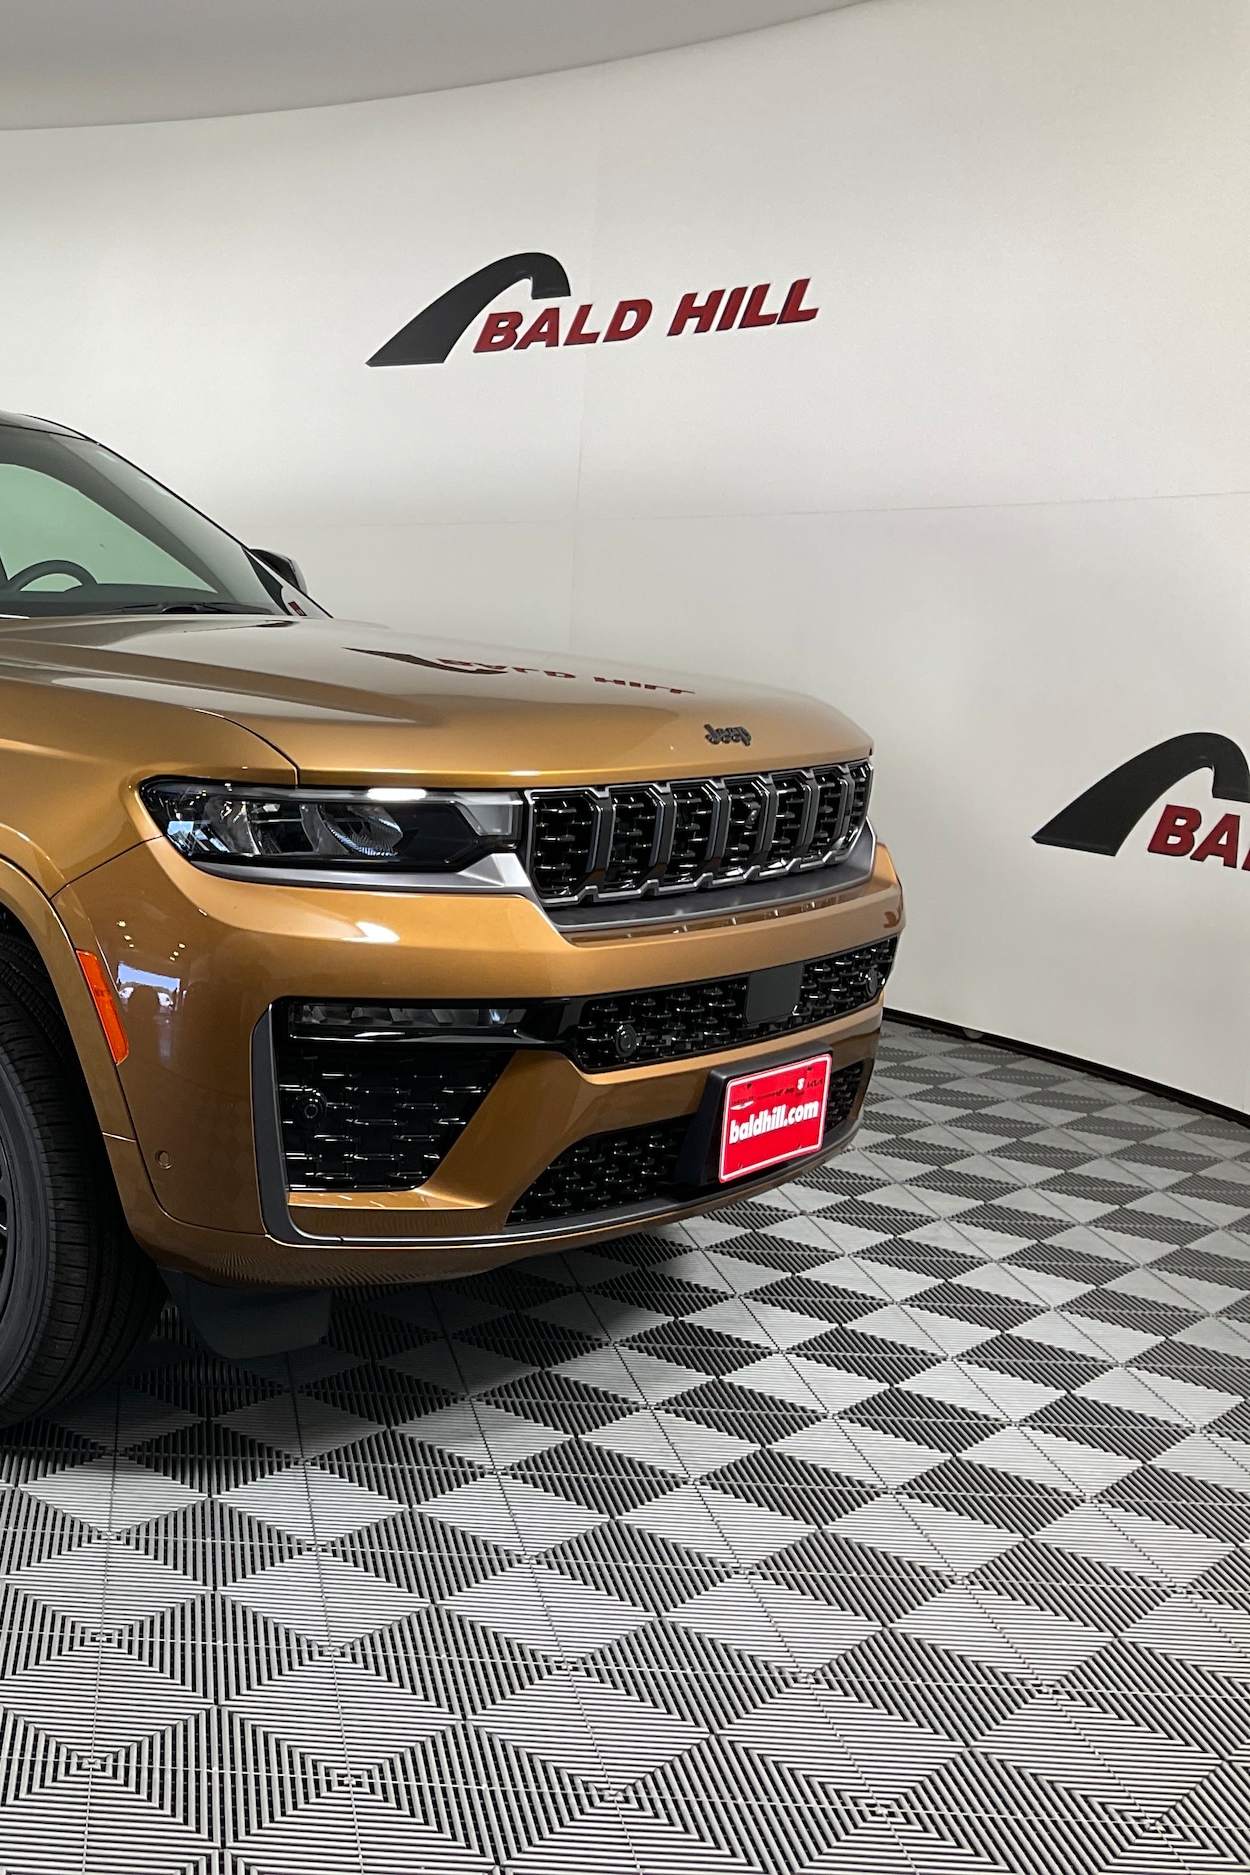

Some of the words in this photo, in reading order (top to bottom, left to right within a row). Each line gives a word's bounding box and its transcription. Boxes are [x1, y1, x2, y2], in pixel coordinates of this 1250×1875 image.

[472, 298, 654, 354] BALD
[666, 277, 820, 337] HILL
[704, 724, 752, 747] Jeep
[1147, 803, 1250, 872] BA
[728, 1100, 820, 1144] baldhill.com
